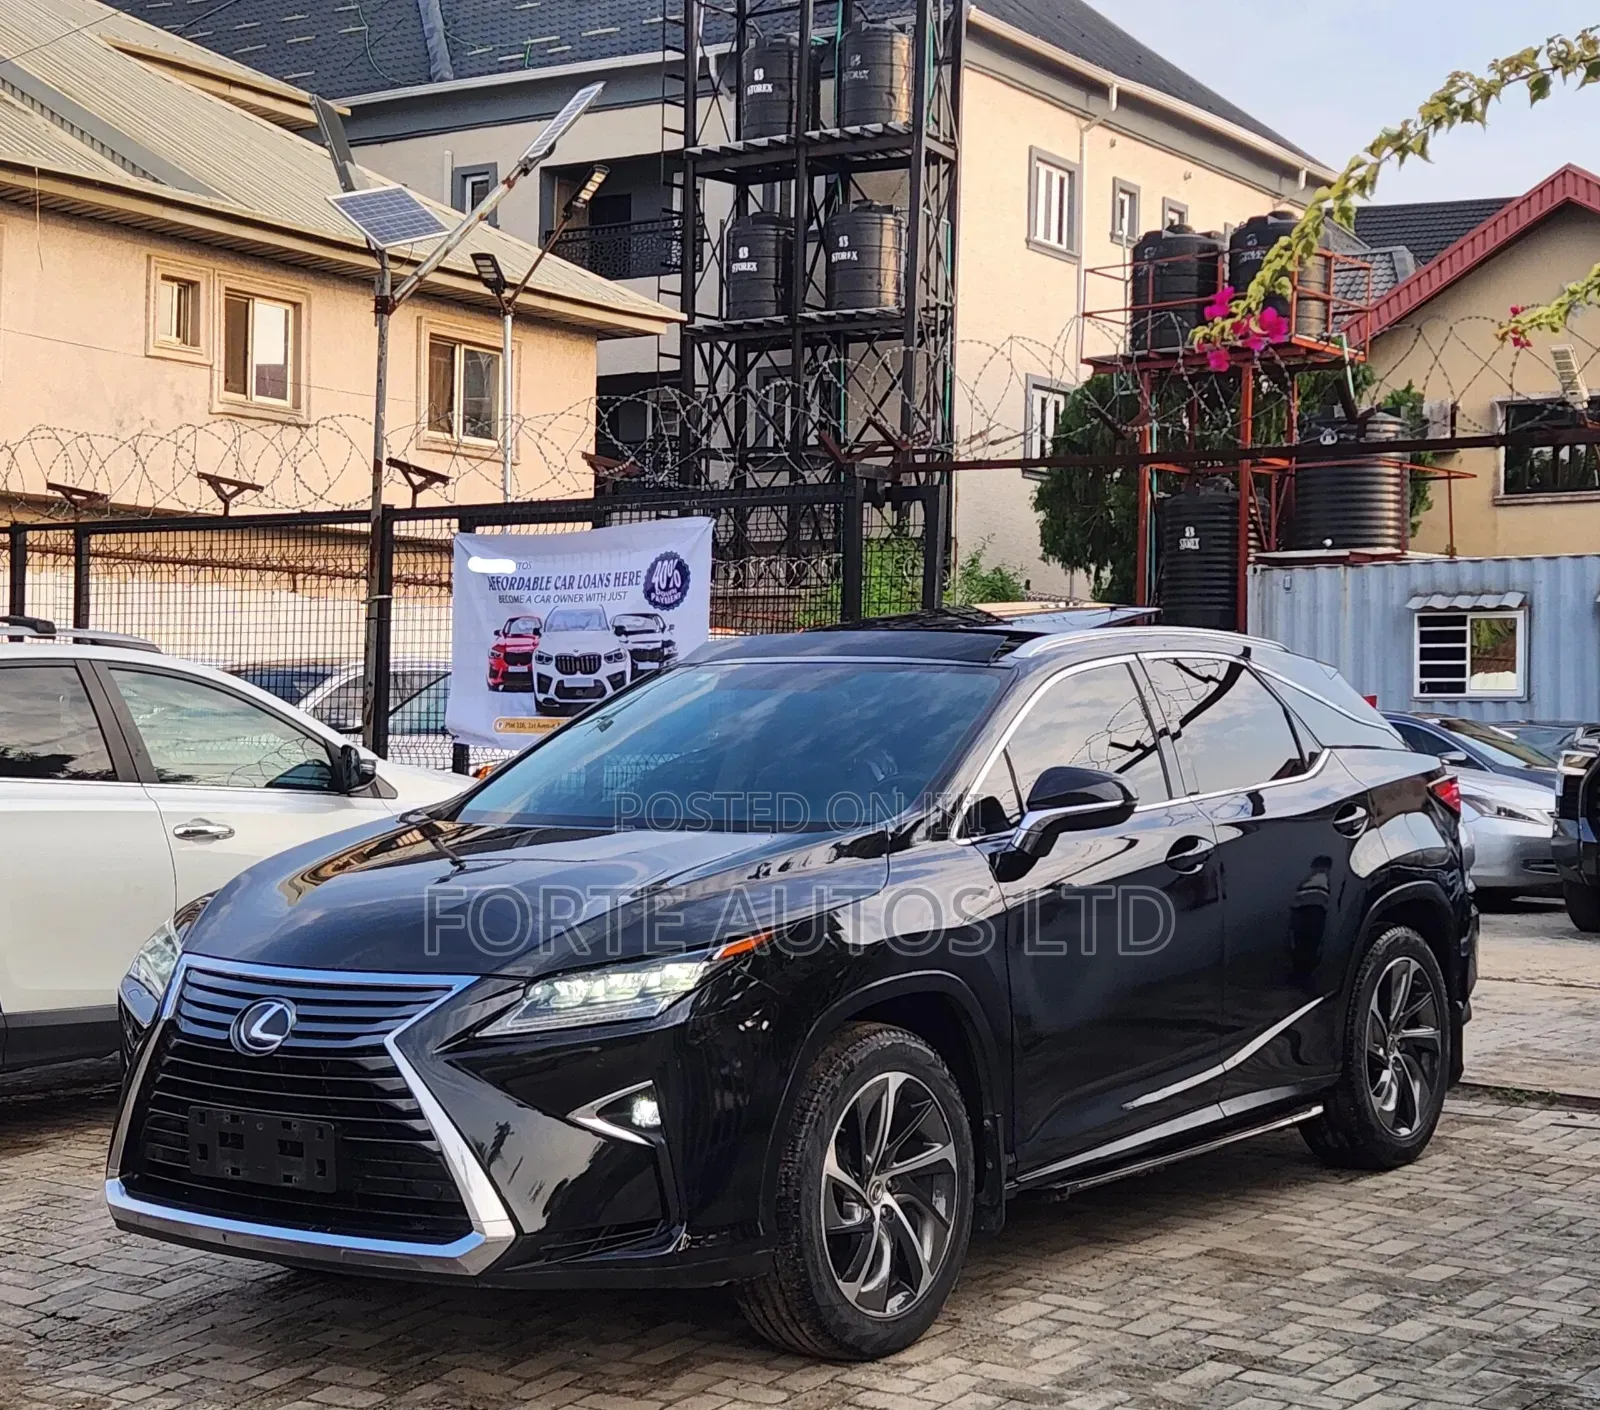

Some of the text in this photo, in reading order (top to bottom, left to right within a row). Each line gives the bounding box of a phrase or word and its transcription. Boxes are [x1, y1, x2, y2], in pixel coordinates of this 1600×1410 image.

[487, 570, 642, 591] AFFORDABLE CAR LOANS HERE
[651, 558, 682, 591] 40%
[498, 591, 628, 604] BECOME A CAR OWNER WITH JUST
